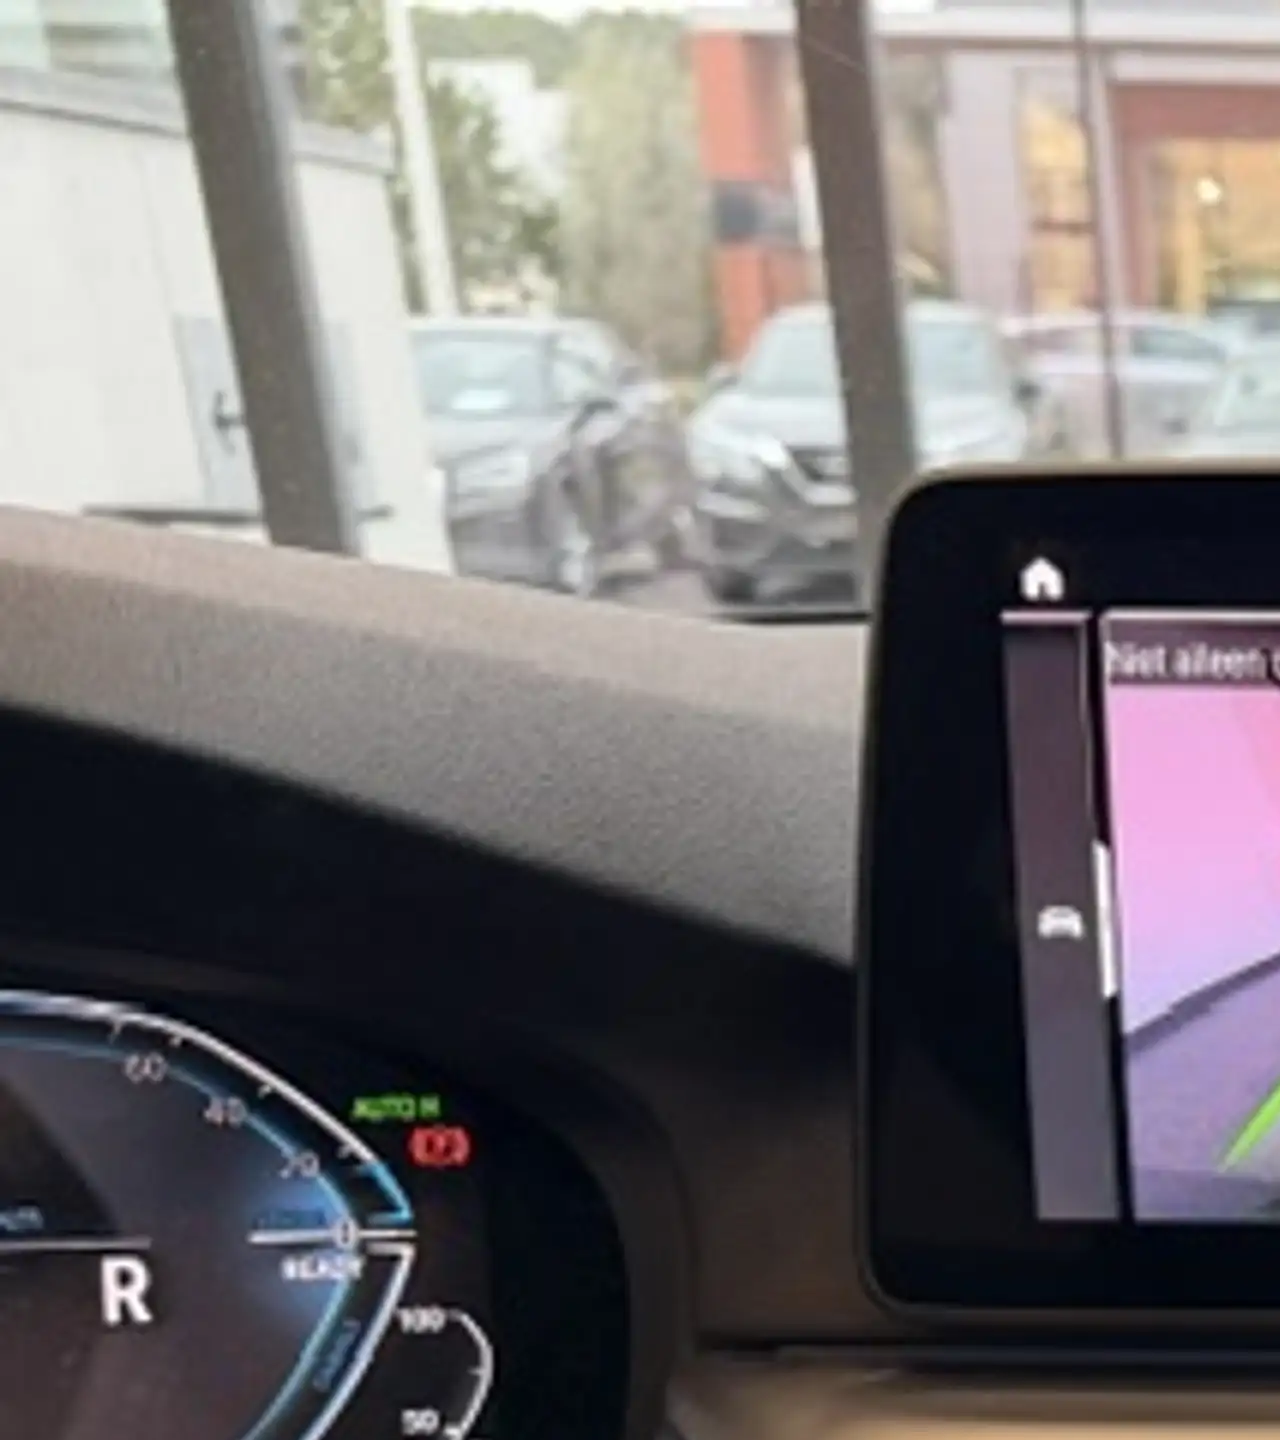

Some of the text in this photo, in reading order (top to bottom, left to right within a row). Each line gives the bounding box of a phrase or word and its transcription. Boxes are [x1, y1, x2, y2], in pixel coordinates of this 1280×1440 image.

[124, 1053, 167, 1082] 60
[203, 1095, 248, 1126] 40
[101, 1253, 152, 1325] R
[402, 1408, 440, 1435] 50
